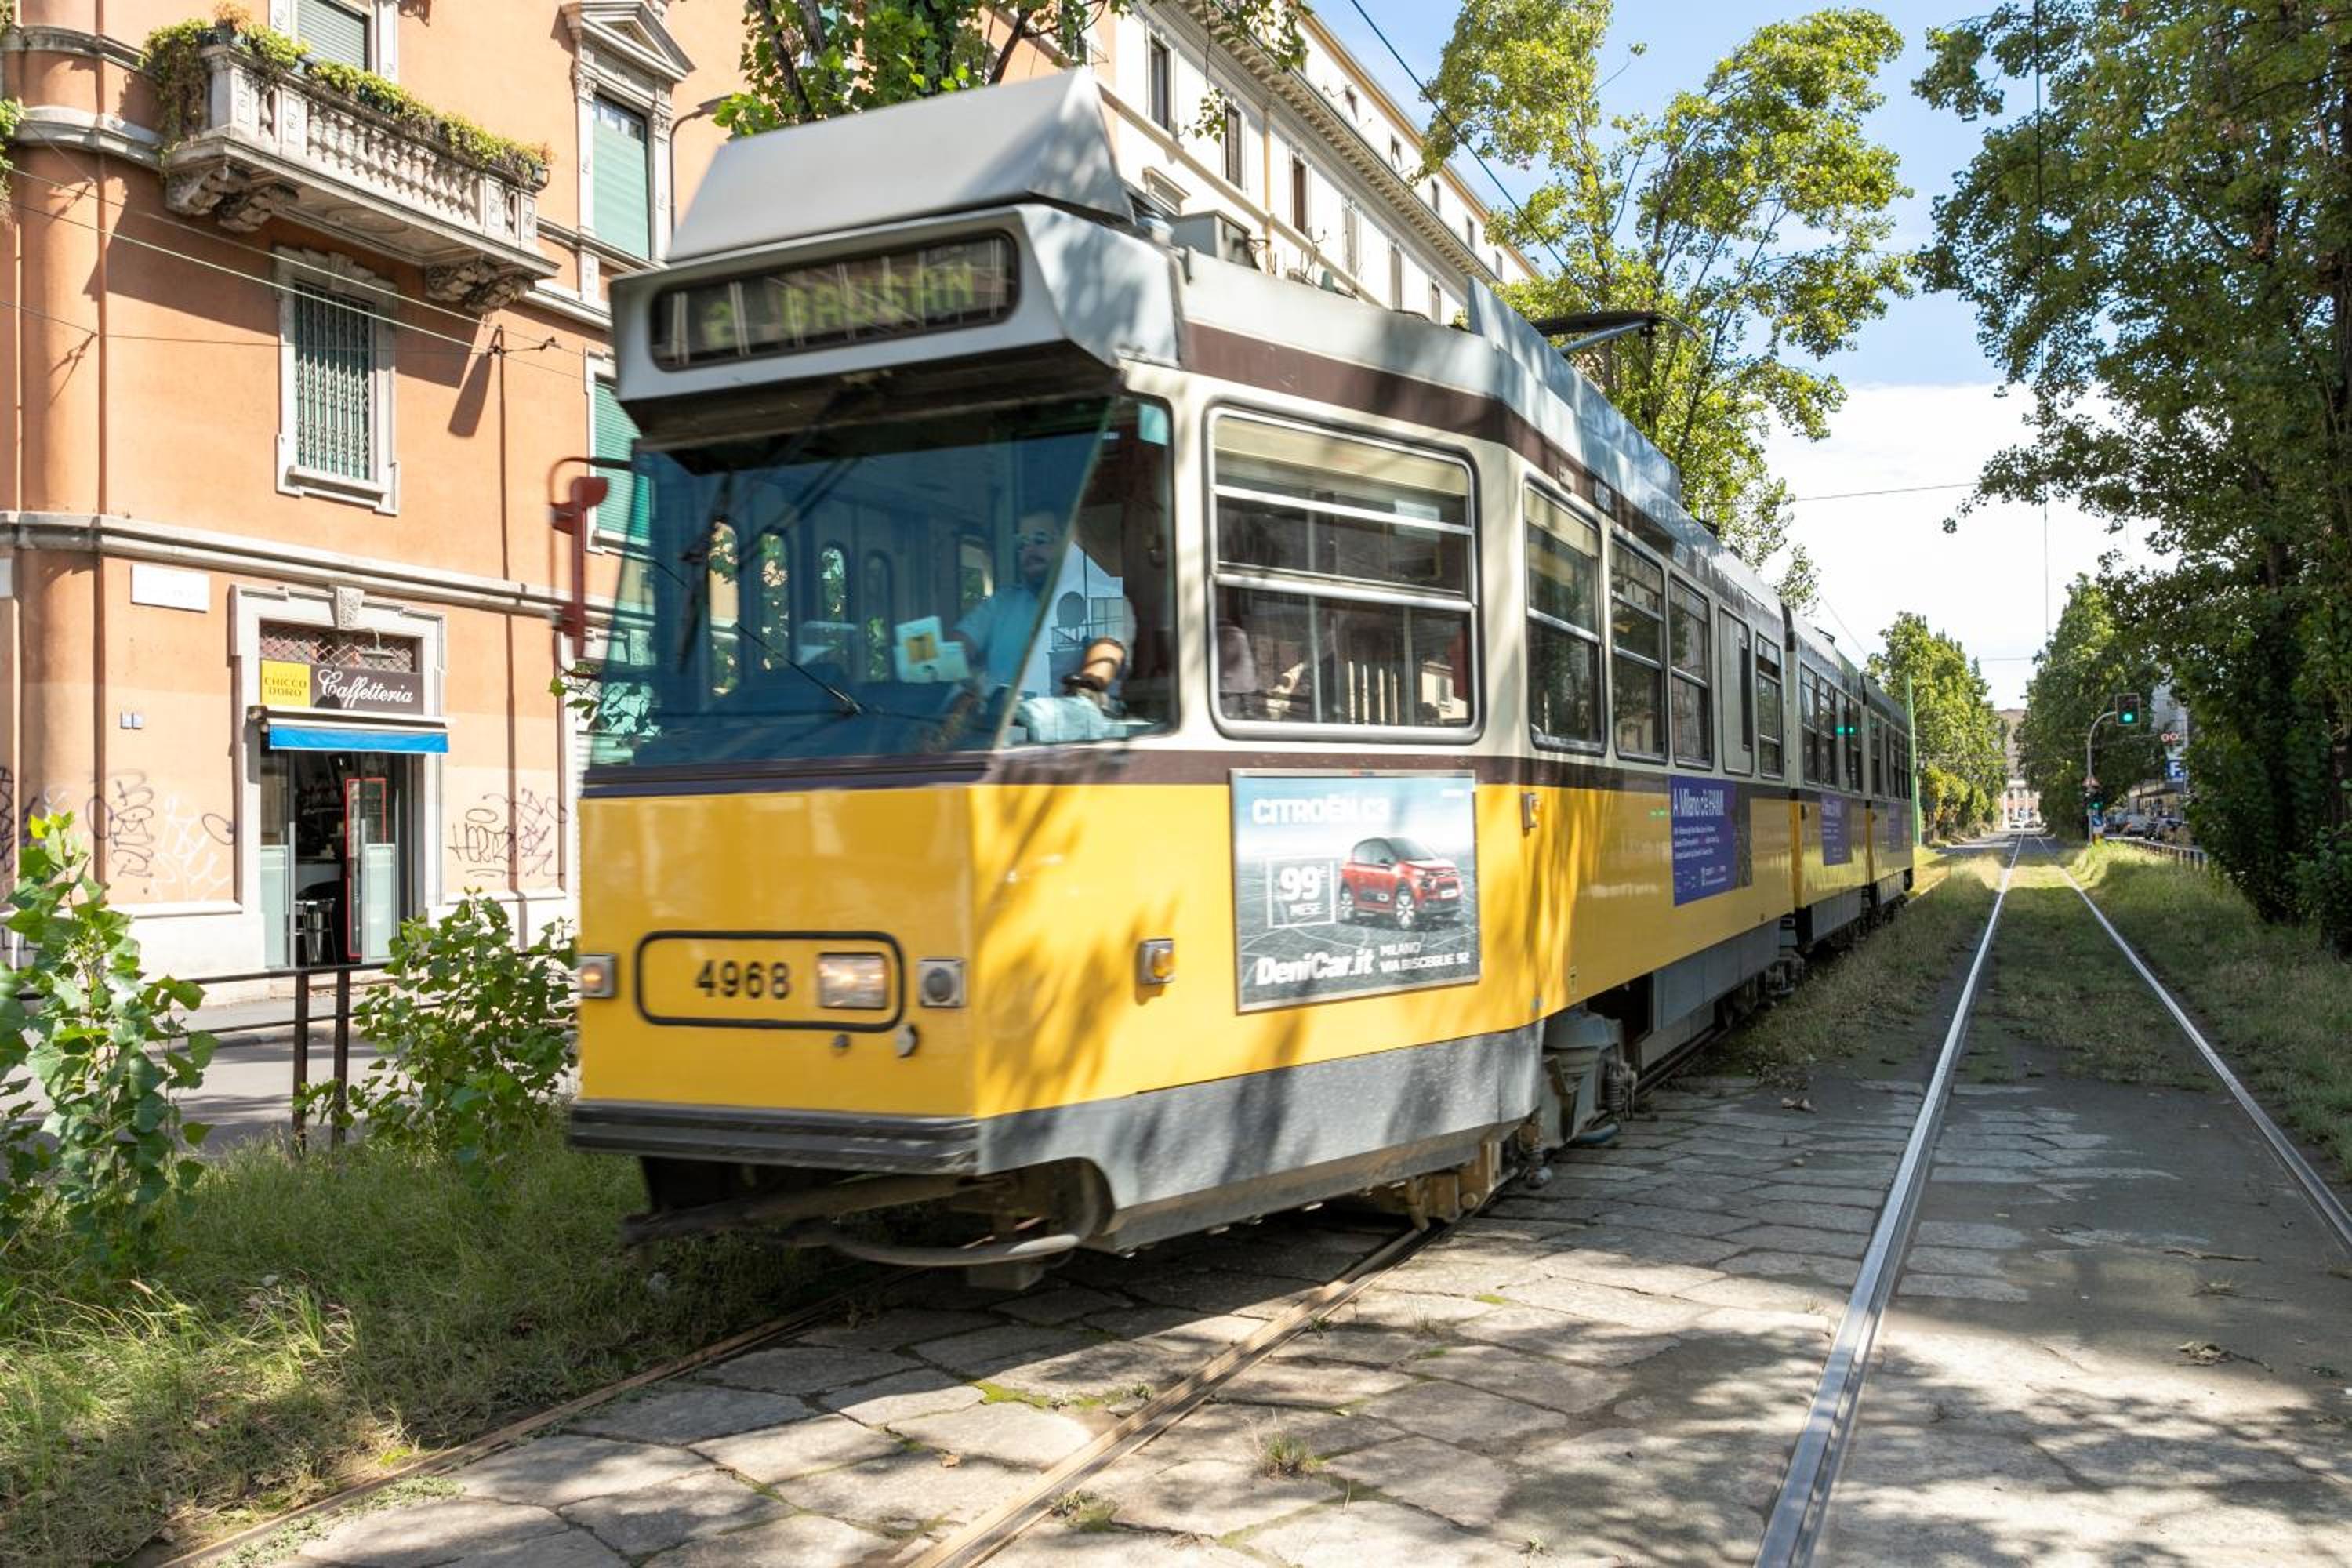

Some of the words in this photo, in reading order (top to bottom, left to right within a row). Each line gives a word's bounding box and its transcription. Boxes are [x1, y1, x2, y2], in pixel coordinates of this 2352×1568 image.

[264, 677, 307, 688] CHICCO
[318, 669, 413, 708] Caffetteria
[1379, 942, 1421, 956] MILANO
[1255, 948, 1375, 985] DeniCar.it
[1379, 959, 1401, 973] VIA
[695, 958, 790, 1000] 4968
